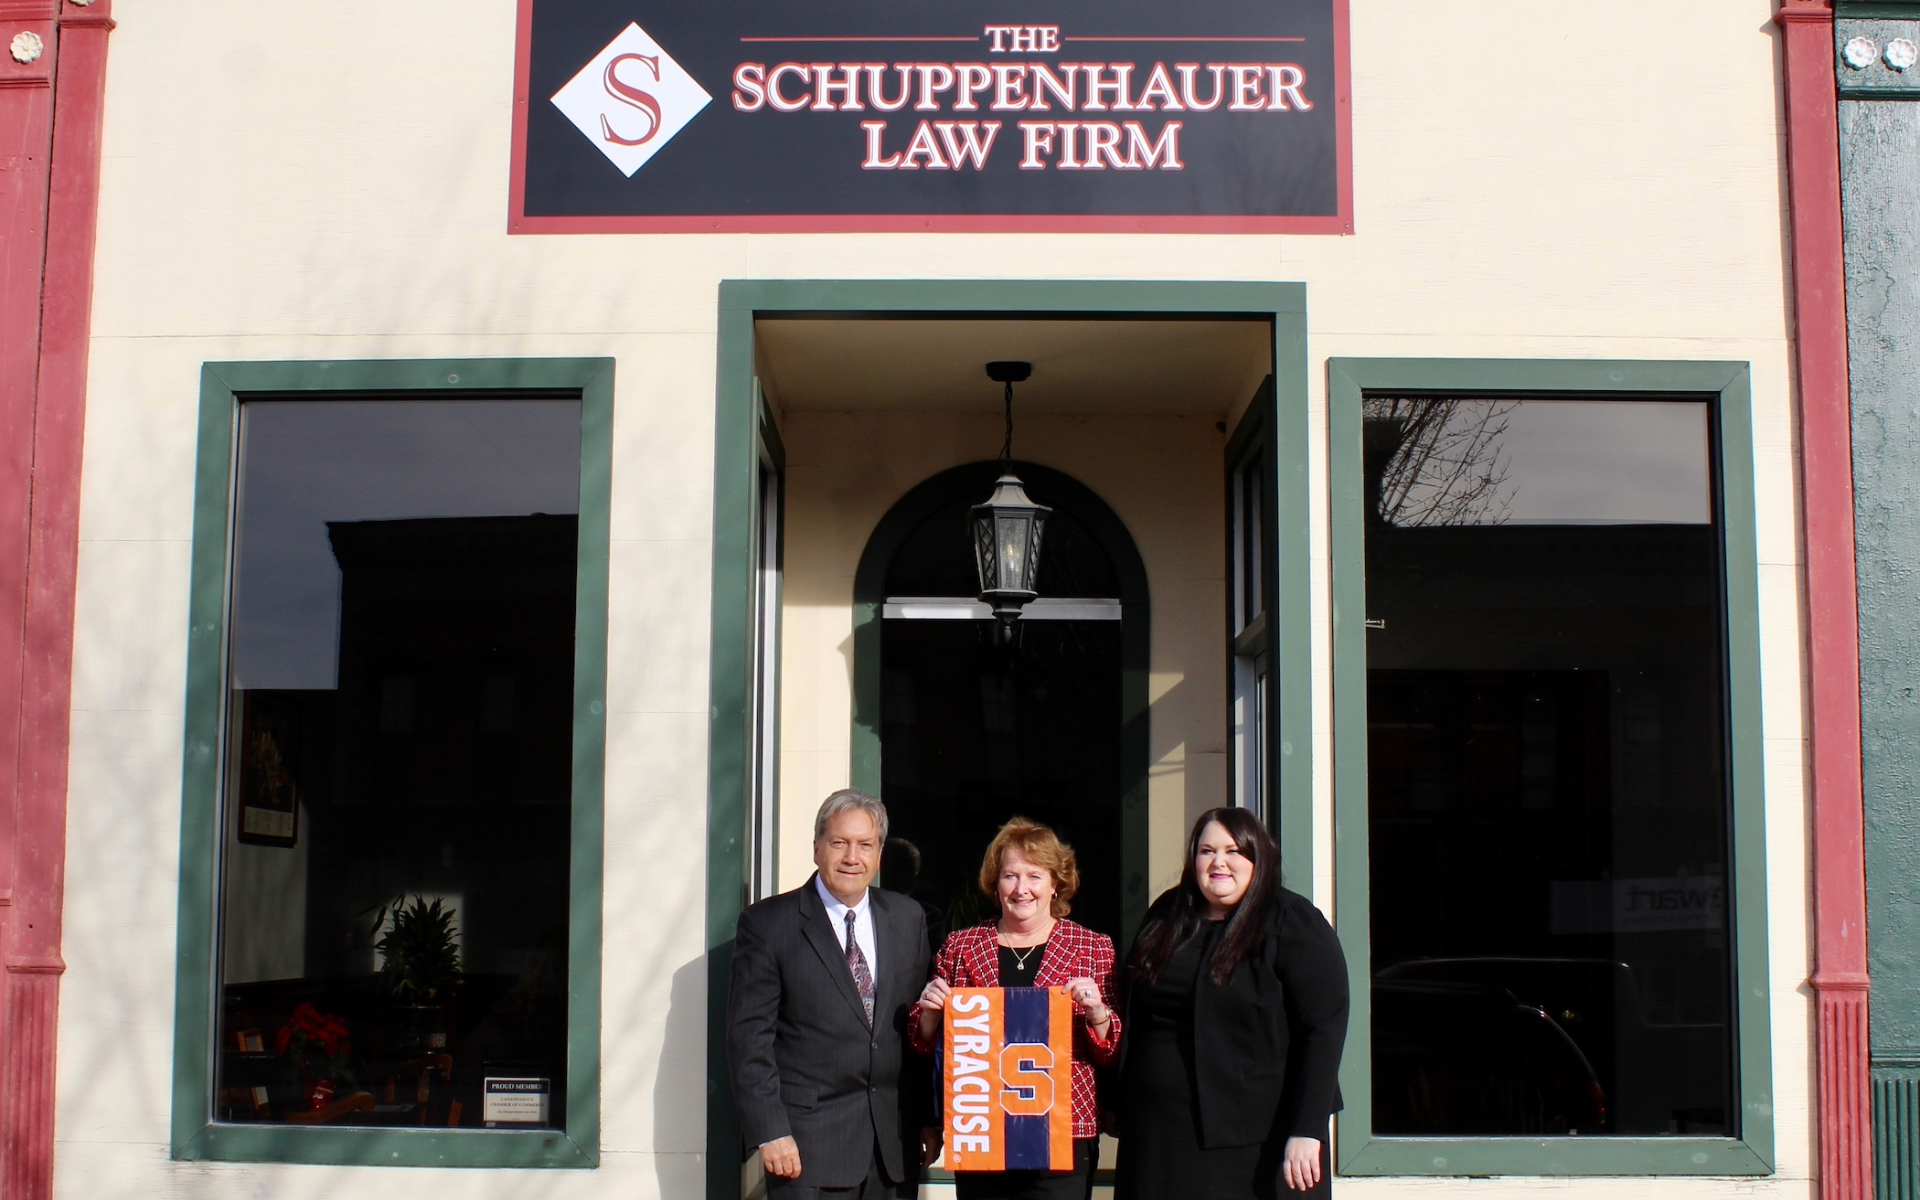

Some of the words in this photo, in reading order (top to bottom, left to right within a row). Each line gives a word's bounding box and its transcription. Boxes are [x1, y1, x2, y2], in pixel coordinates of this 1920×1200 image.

[984, 24, 1060, 53] THE
[600, 53, 662, 145] S
[732, 62, 1313, 113] SCHUPPENHAUER
[862, 121, 1002, 171] LAW
[1021, 121, 1184, 172] FIRM
[999, 1043, 1055, 1116] S
